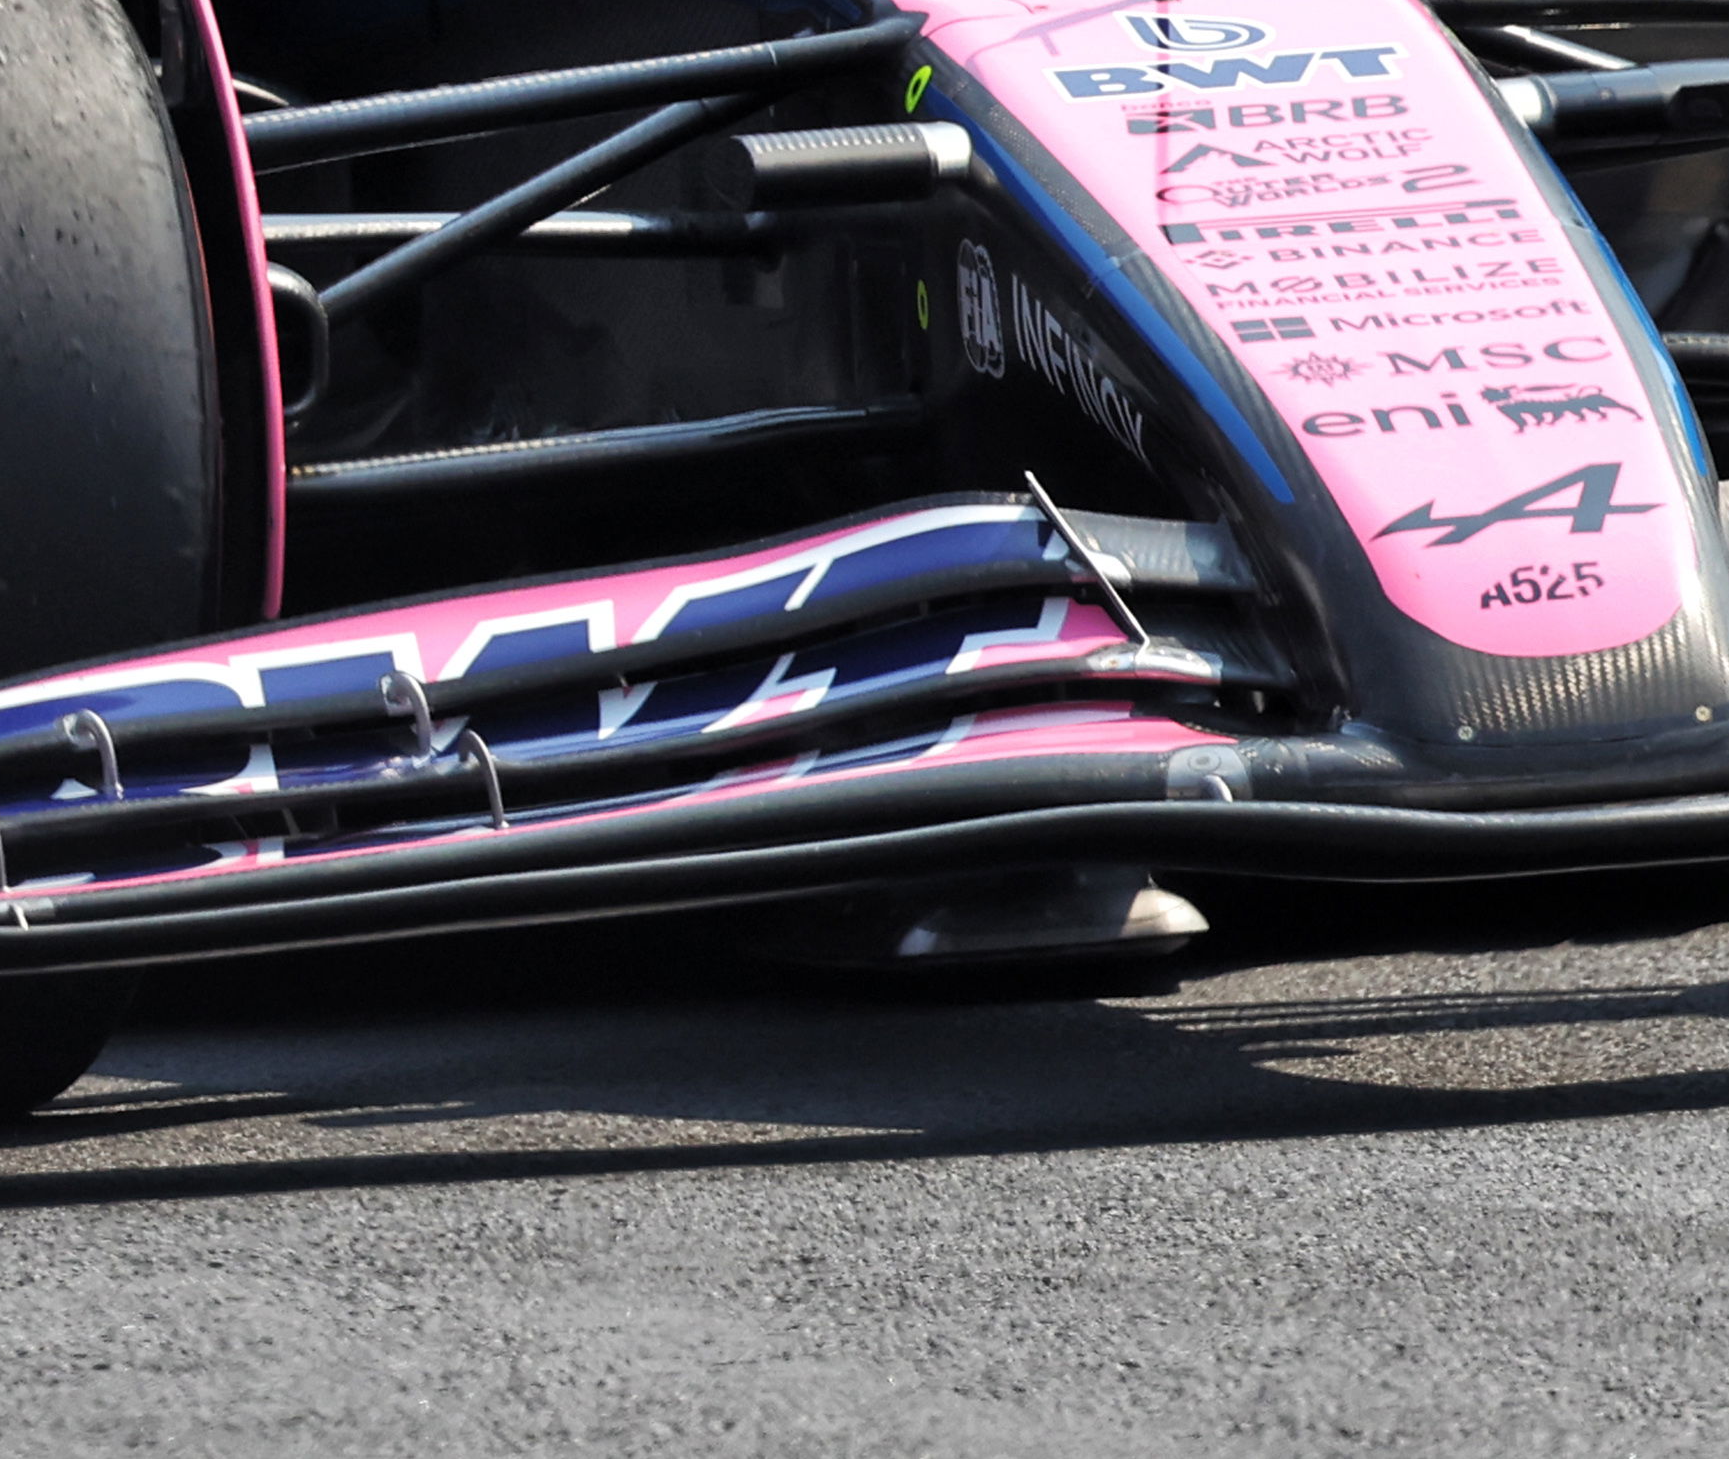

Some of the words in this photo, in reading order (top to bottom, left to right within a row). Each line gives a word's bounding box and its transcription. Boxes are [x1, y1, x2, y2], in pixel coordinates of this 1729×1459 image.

[1052, 46, 1398, 99] BWT
[1227, 93, 1410, 129] BRB
[1252, 127, 1434, 153] ARCTIC
[1282, 143, 1425, 165] WOLF
[1213, 174, 1391, 209] WORLDS
[1402, 164, 1479, 193] 2
[1156, 198, 1523, 246] PIRELLI
[1268, 229, 1545, 262] BINANCE
[1216, 289, 1397, 311] FINANCIAL
[1403, 276, 1562, 298] SERVICES
[1329, 299, 1592, 332] Microsoft
[1377, 336, 1613, 378] MSC
[1301, 392, 1473, 438] eni
[1480, 561, 1605, 609] A525
